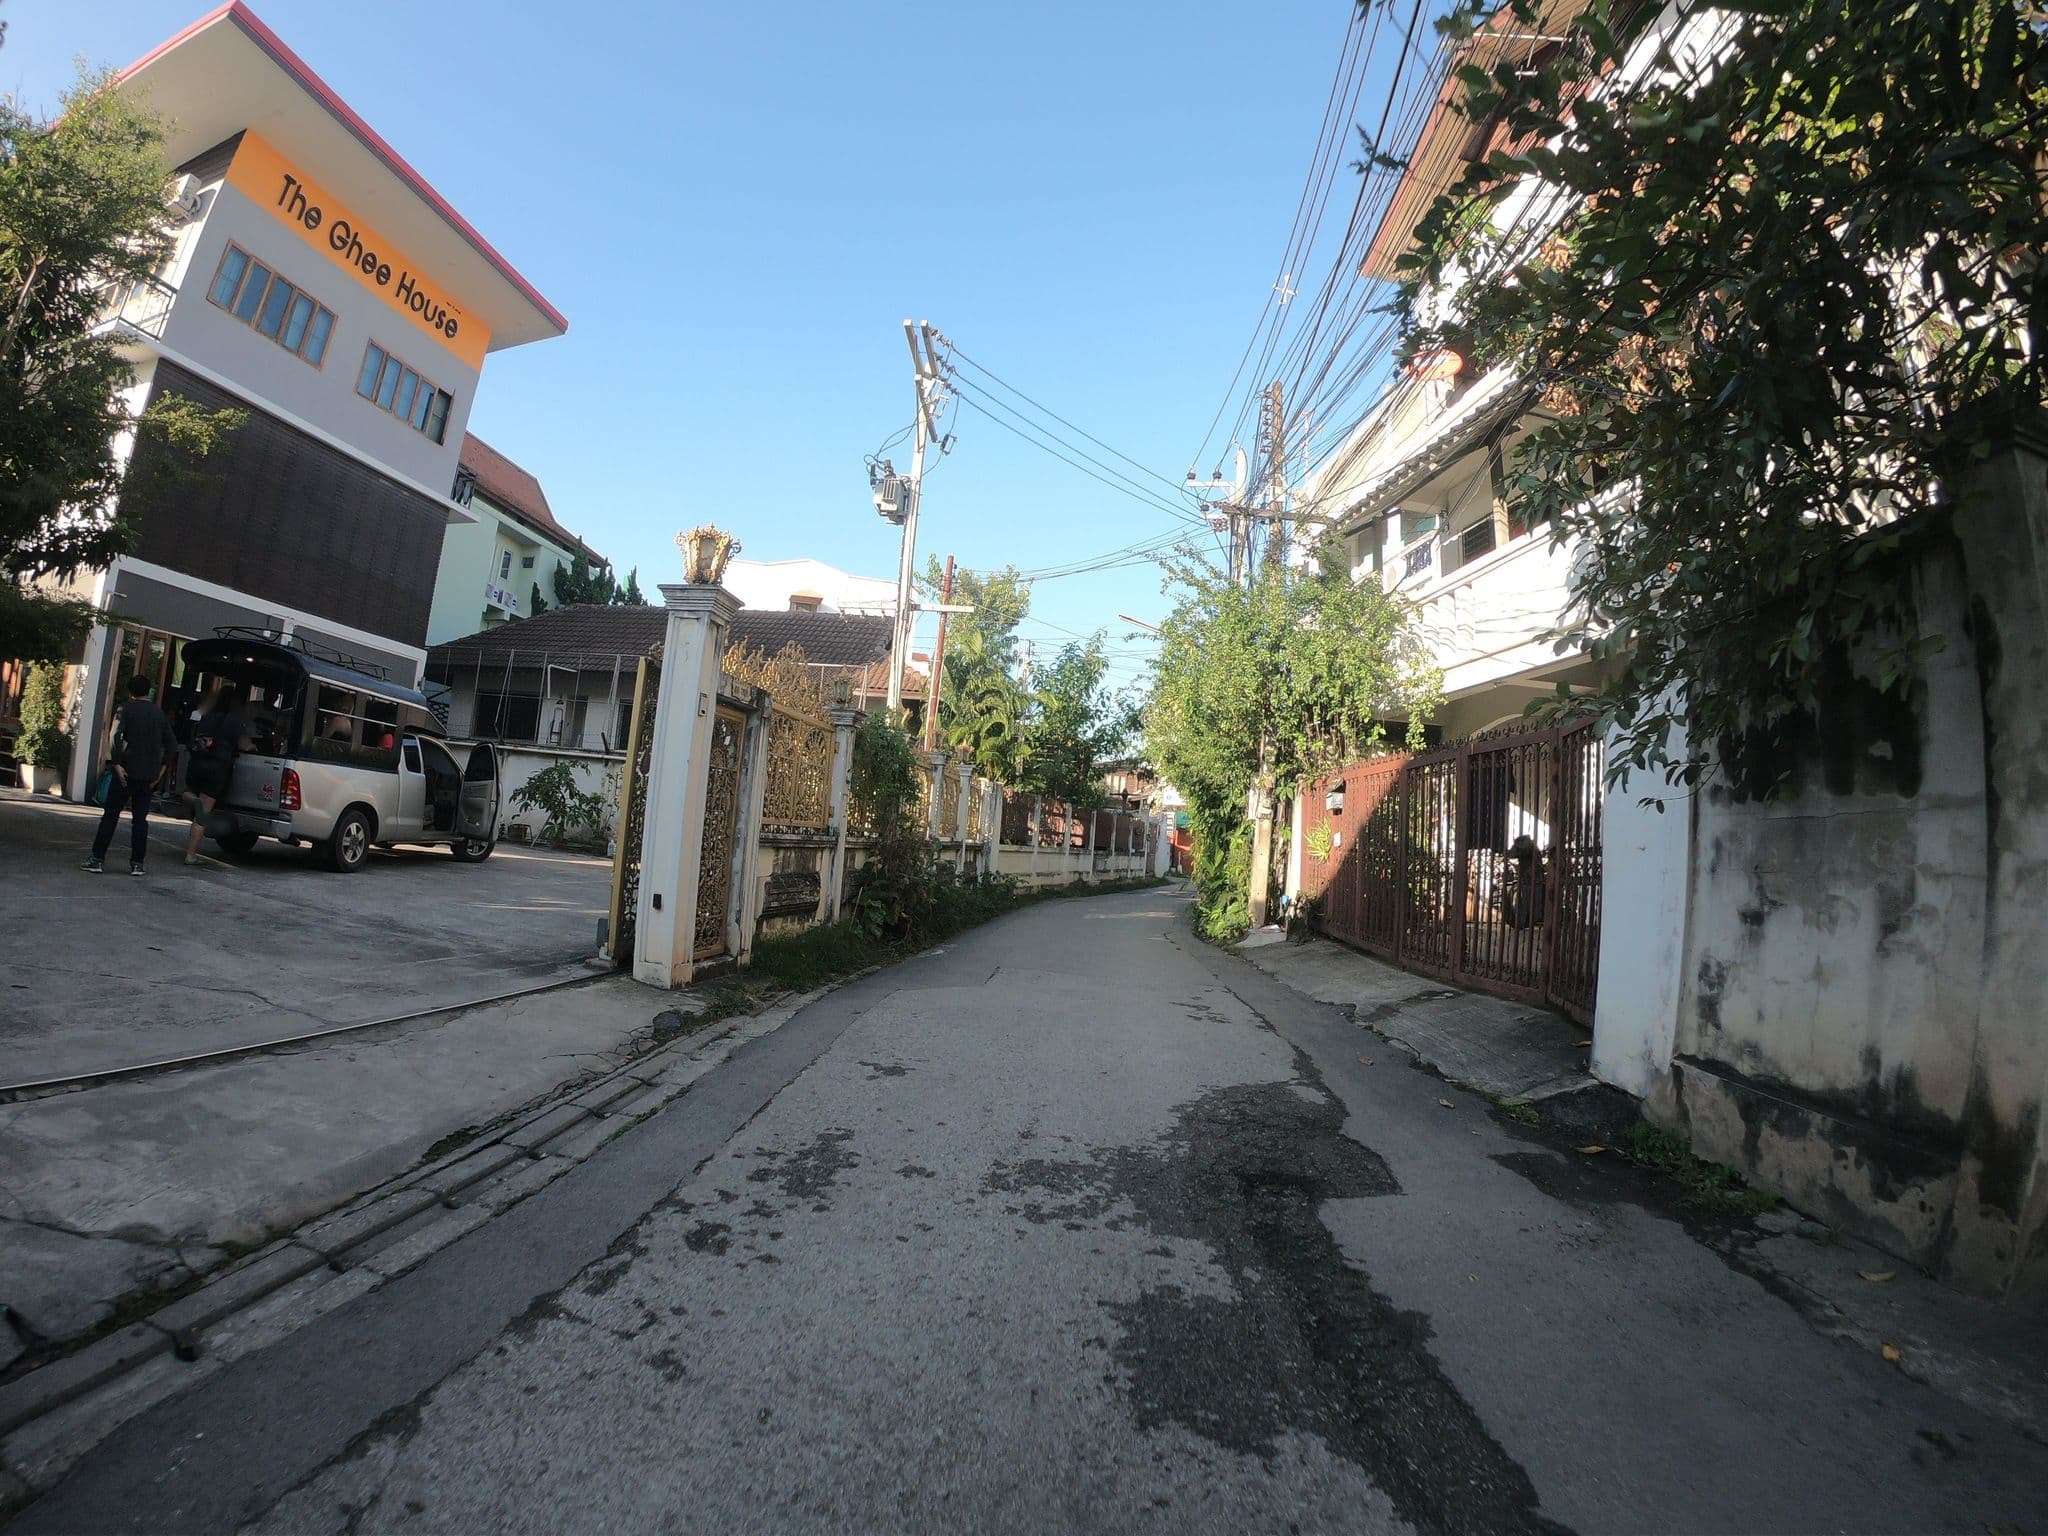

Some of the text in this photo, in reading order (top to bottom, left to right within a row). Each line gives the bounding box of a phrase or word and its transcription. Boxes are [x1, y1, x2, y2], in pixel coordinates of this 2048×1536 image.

[278, 173, 458, 339] The Ghee House
